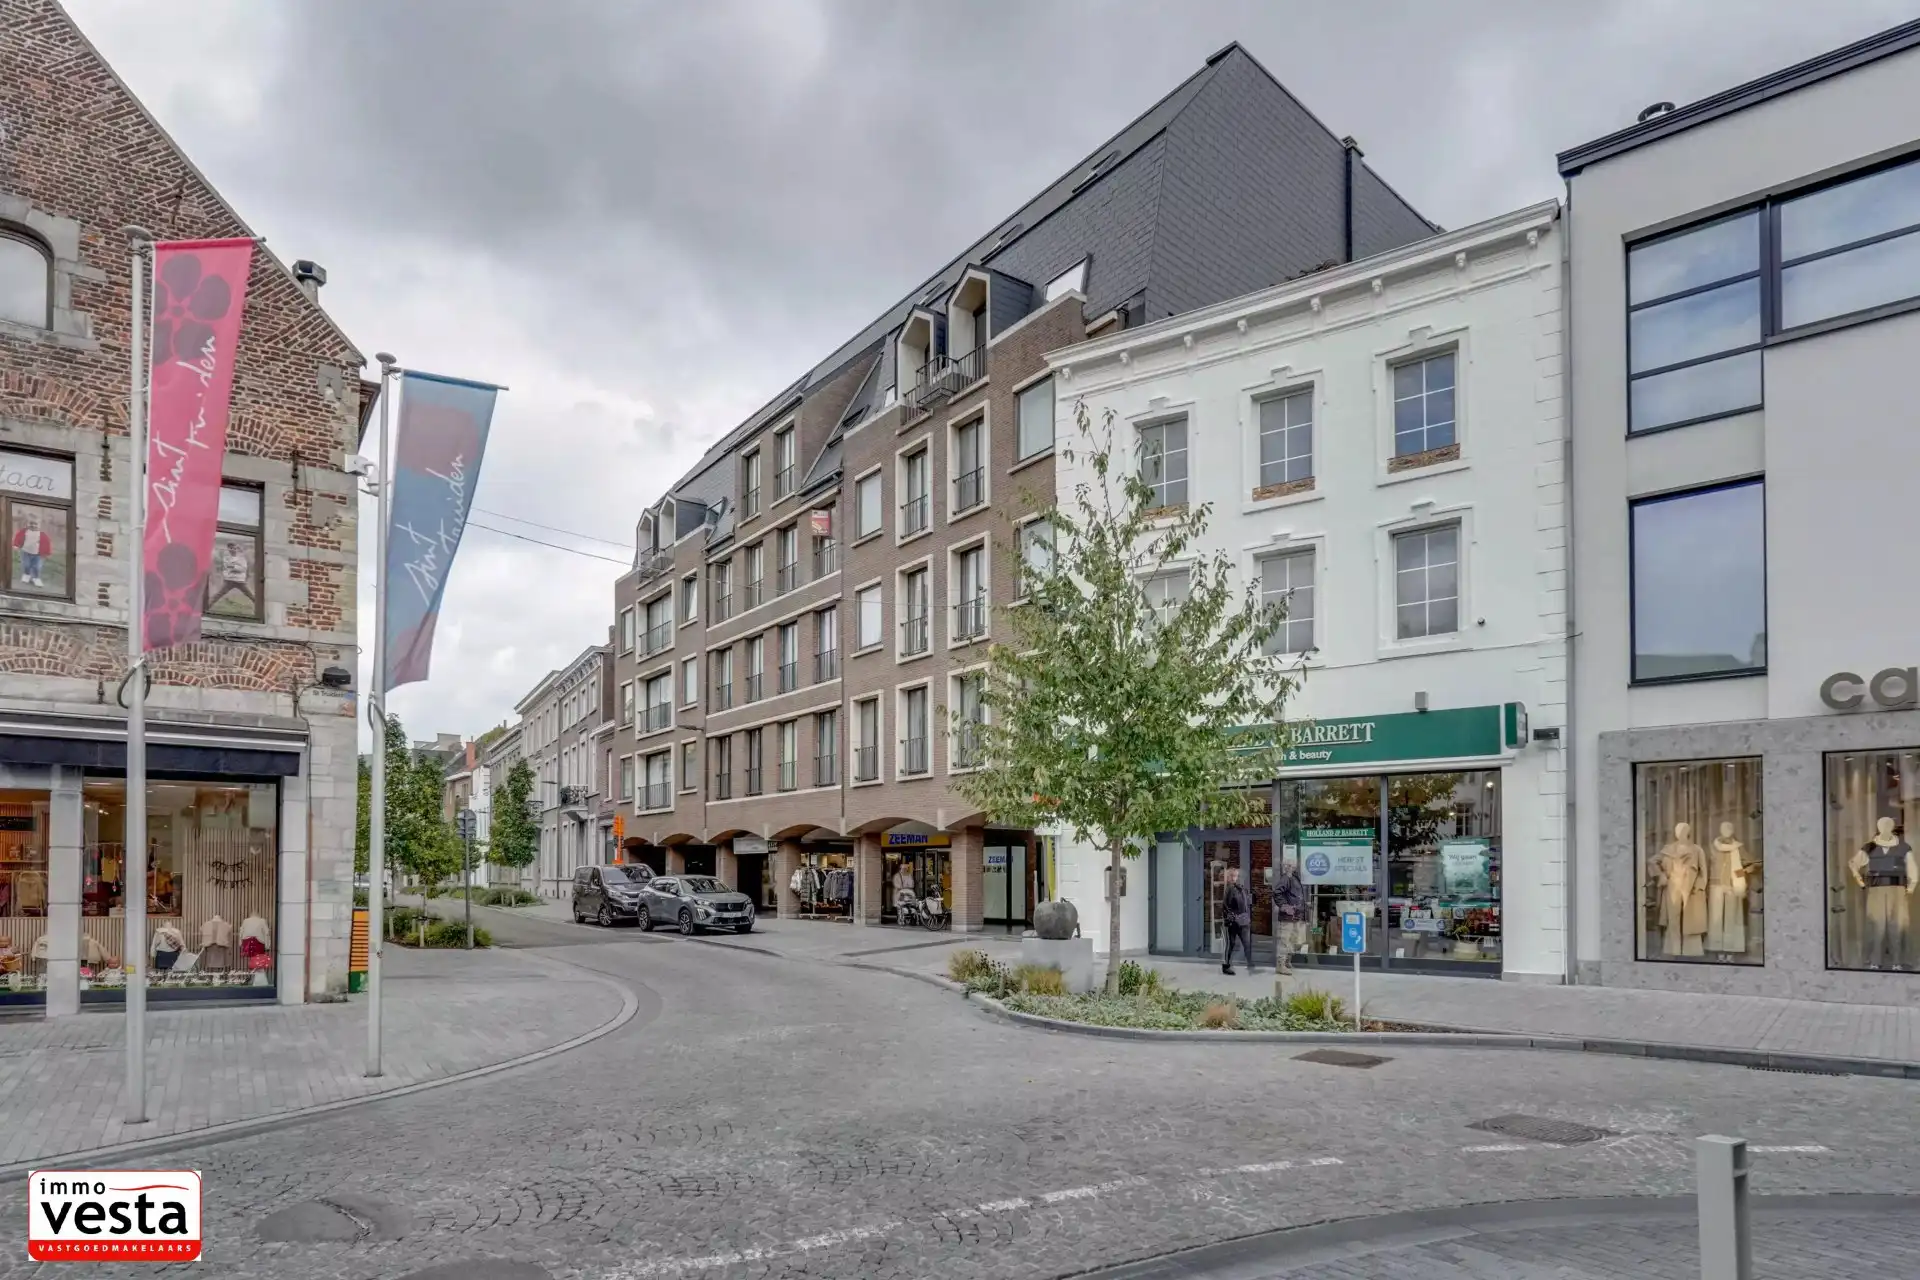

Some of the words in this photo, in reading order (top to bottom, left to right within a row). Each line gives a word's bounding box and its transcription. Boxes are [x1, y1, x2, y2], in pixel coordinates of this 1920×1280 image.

[1291, 722, 1376, 744] BARRETT
[1299, 749, 1332, 761] beauty
[888, 833, 928, 845] ZEEMAN
